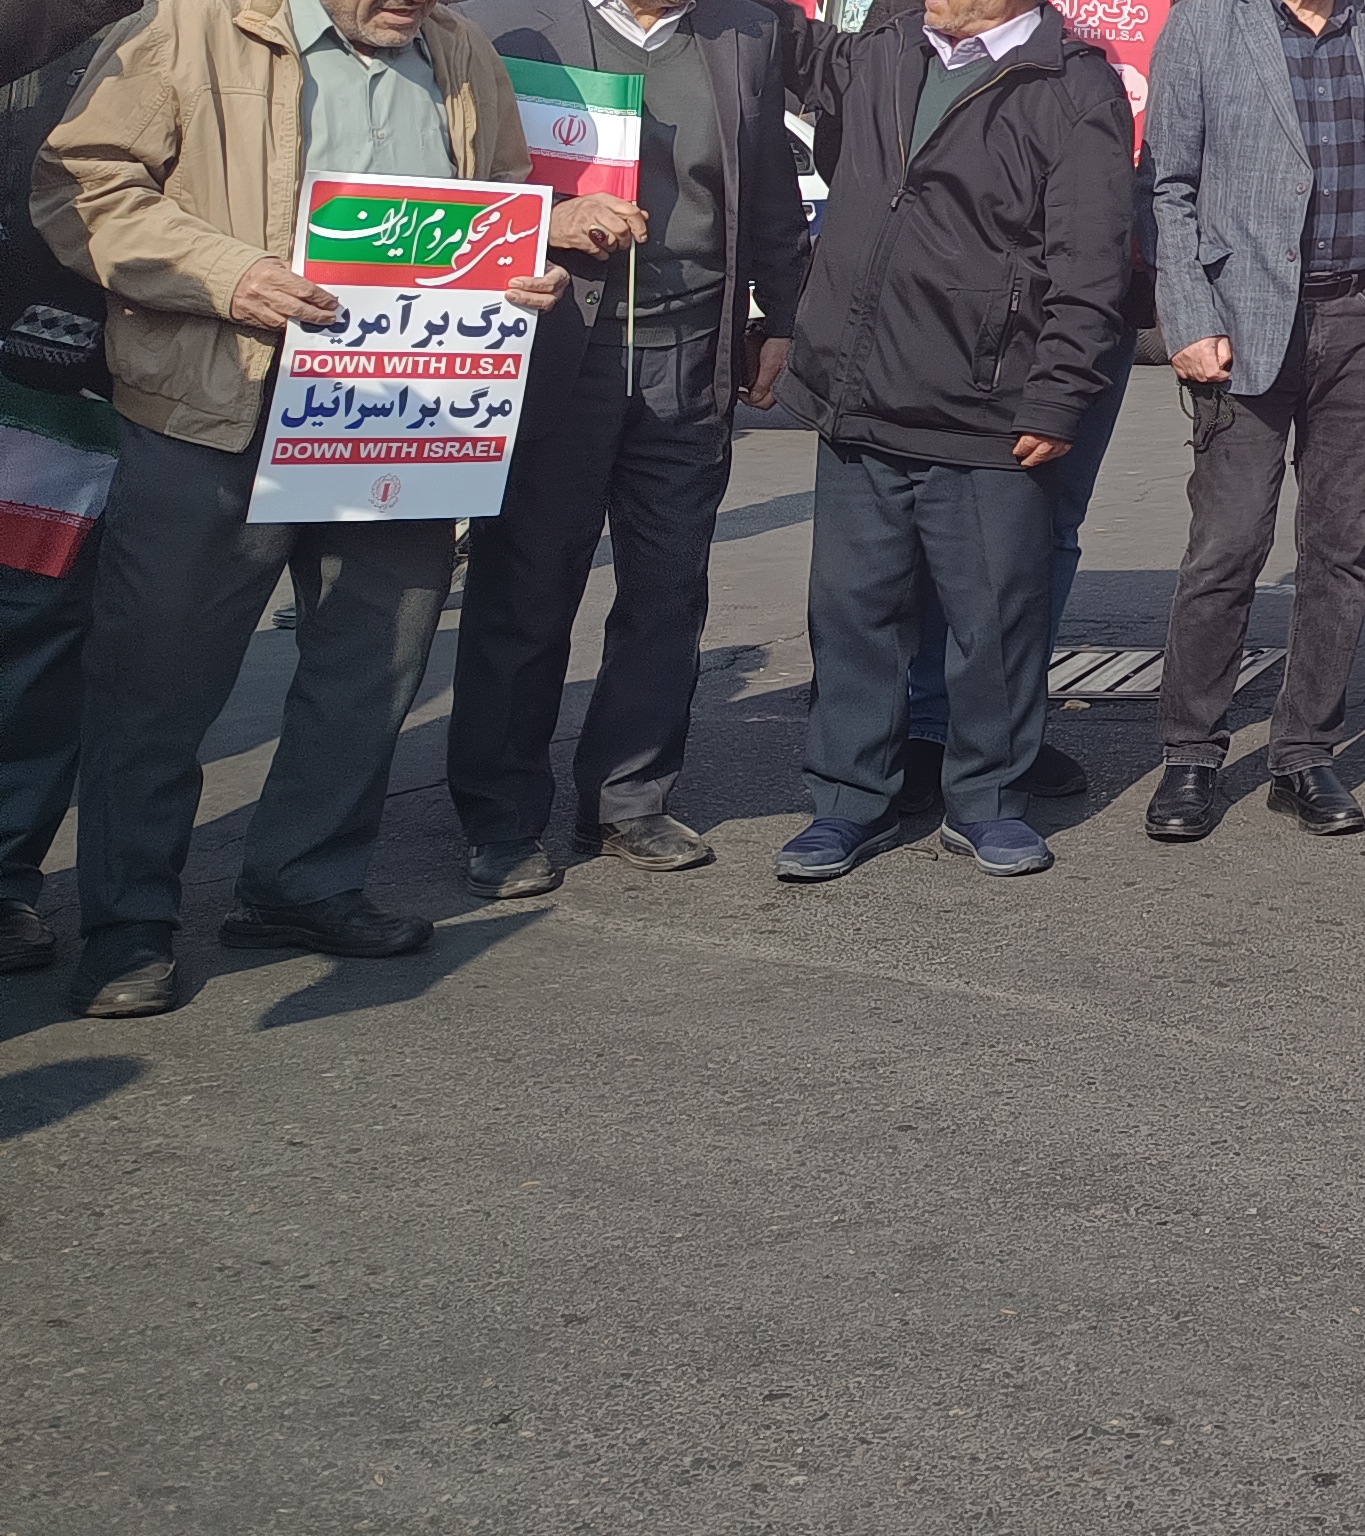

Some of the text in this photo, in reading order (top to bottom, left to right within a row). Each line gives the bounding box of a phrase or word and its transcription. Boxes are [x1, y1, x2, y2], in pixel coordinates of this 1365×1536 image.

[1105, 29, 1146, 43] U.S.A
[410, 309, 451, 349] بر
[456, 301, 529, 350] مرگ
[293, 354, 517, 376] DOWN WITH U.S.A
[280, 381, 514, 430] مرگ بر اسرائیل
[275, 440, 503, 459] DOWN WITH ISRAEL
